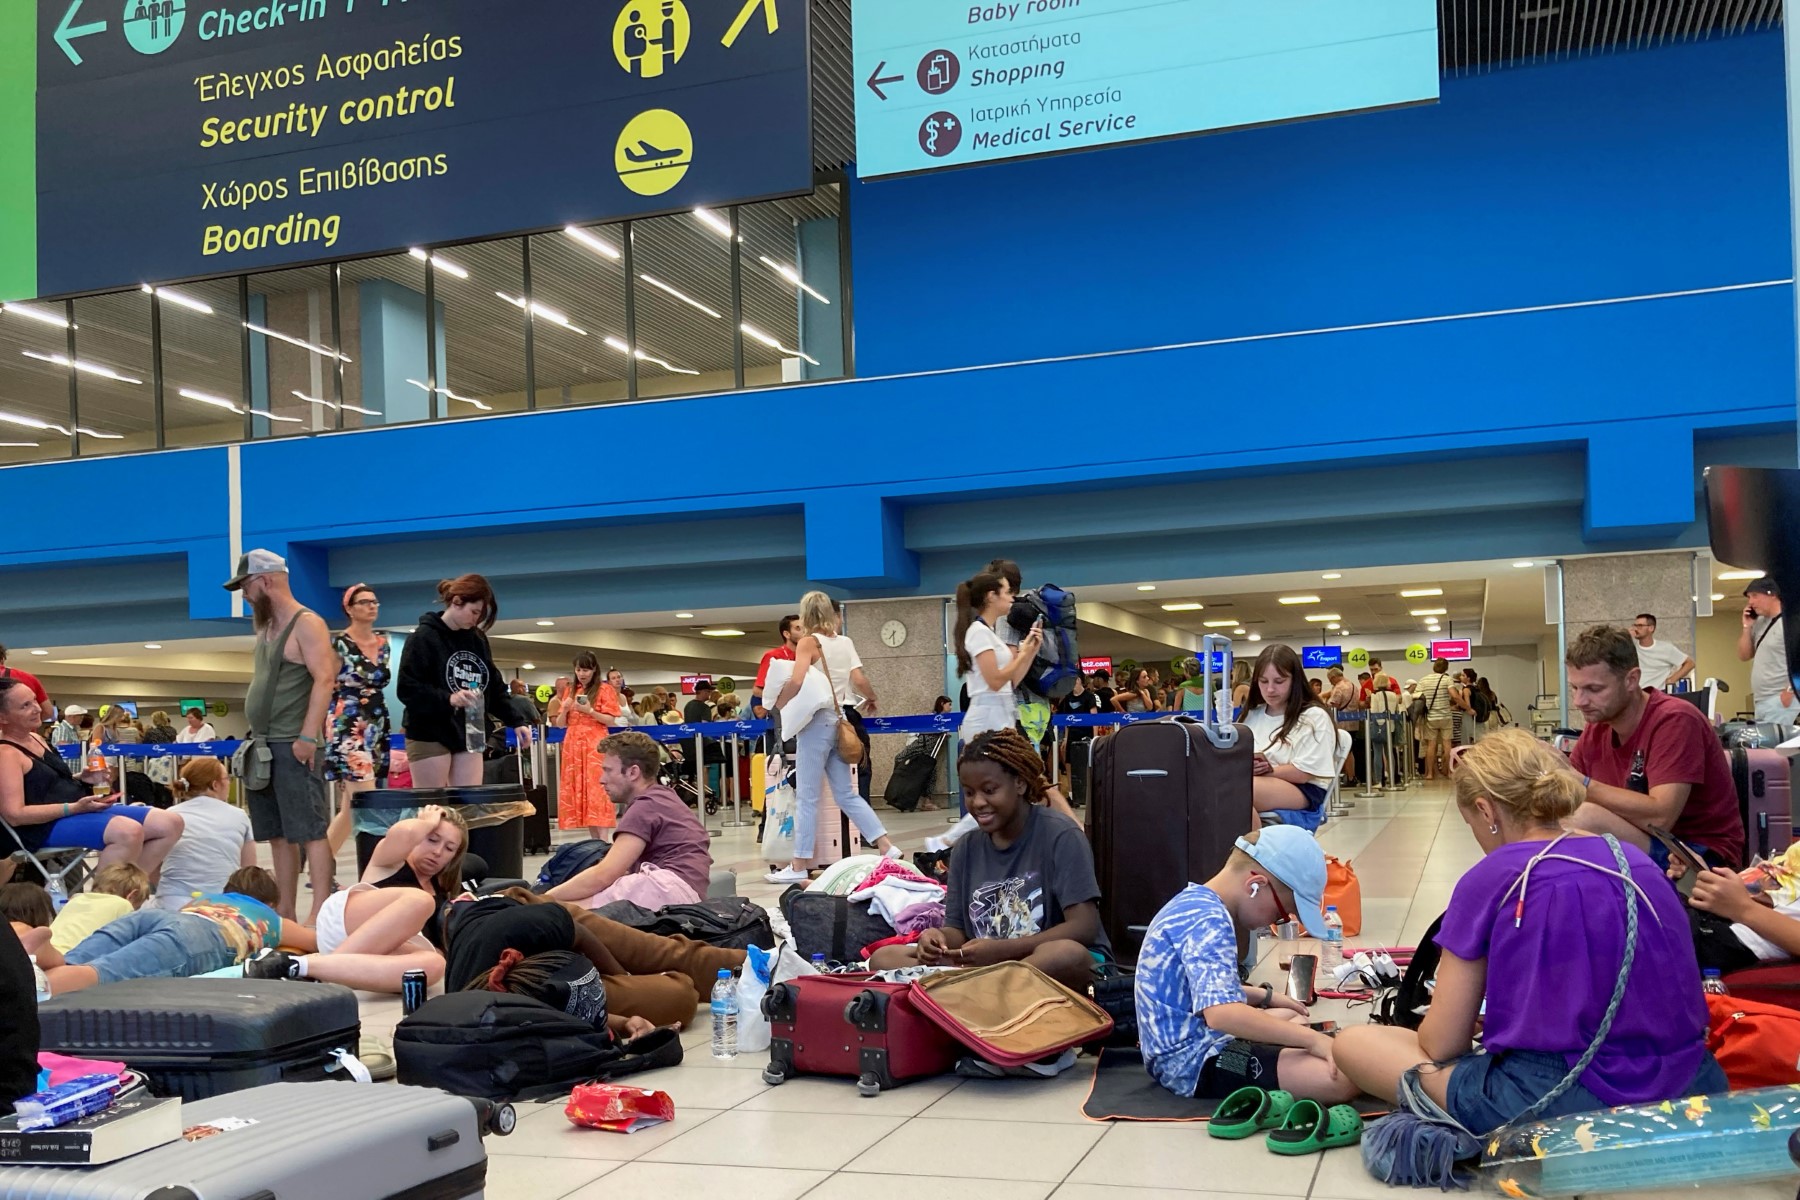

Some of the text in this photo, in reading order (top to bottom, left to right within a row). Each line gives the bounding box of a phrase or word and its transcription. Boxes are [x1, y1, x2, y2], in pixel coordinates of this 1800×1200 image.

[198, 0, 327, 41] Check-in
[967, 2, 1020, 24] Baby
[969, 32, 1082, 61] Καταστήματα
[194, 33, 463, 102] Έλεγχος Ασφαλείας
[970, 60, 1066, 88] Shopping
[200, 77, 456, 148] Security control
[970, 87, 1121, 123] Ιατρική Υπηρεσία
[972, 114, 1137, 151] Medical Service
[201, 154, 449, 210] Χώρος Επιβίβασης
[202, 211, 342, 257] Boarding
[462, 663, 472, 672] THE
[1351, 653, 1367, 662] 44
[1408, 649, 1425, 659] 45
[538, 689, 550, 698] 36
[720, 681, 732, 690] 38
